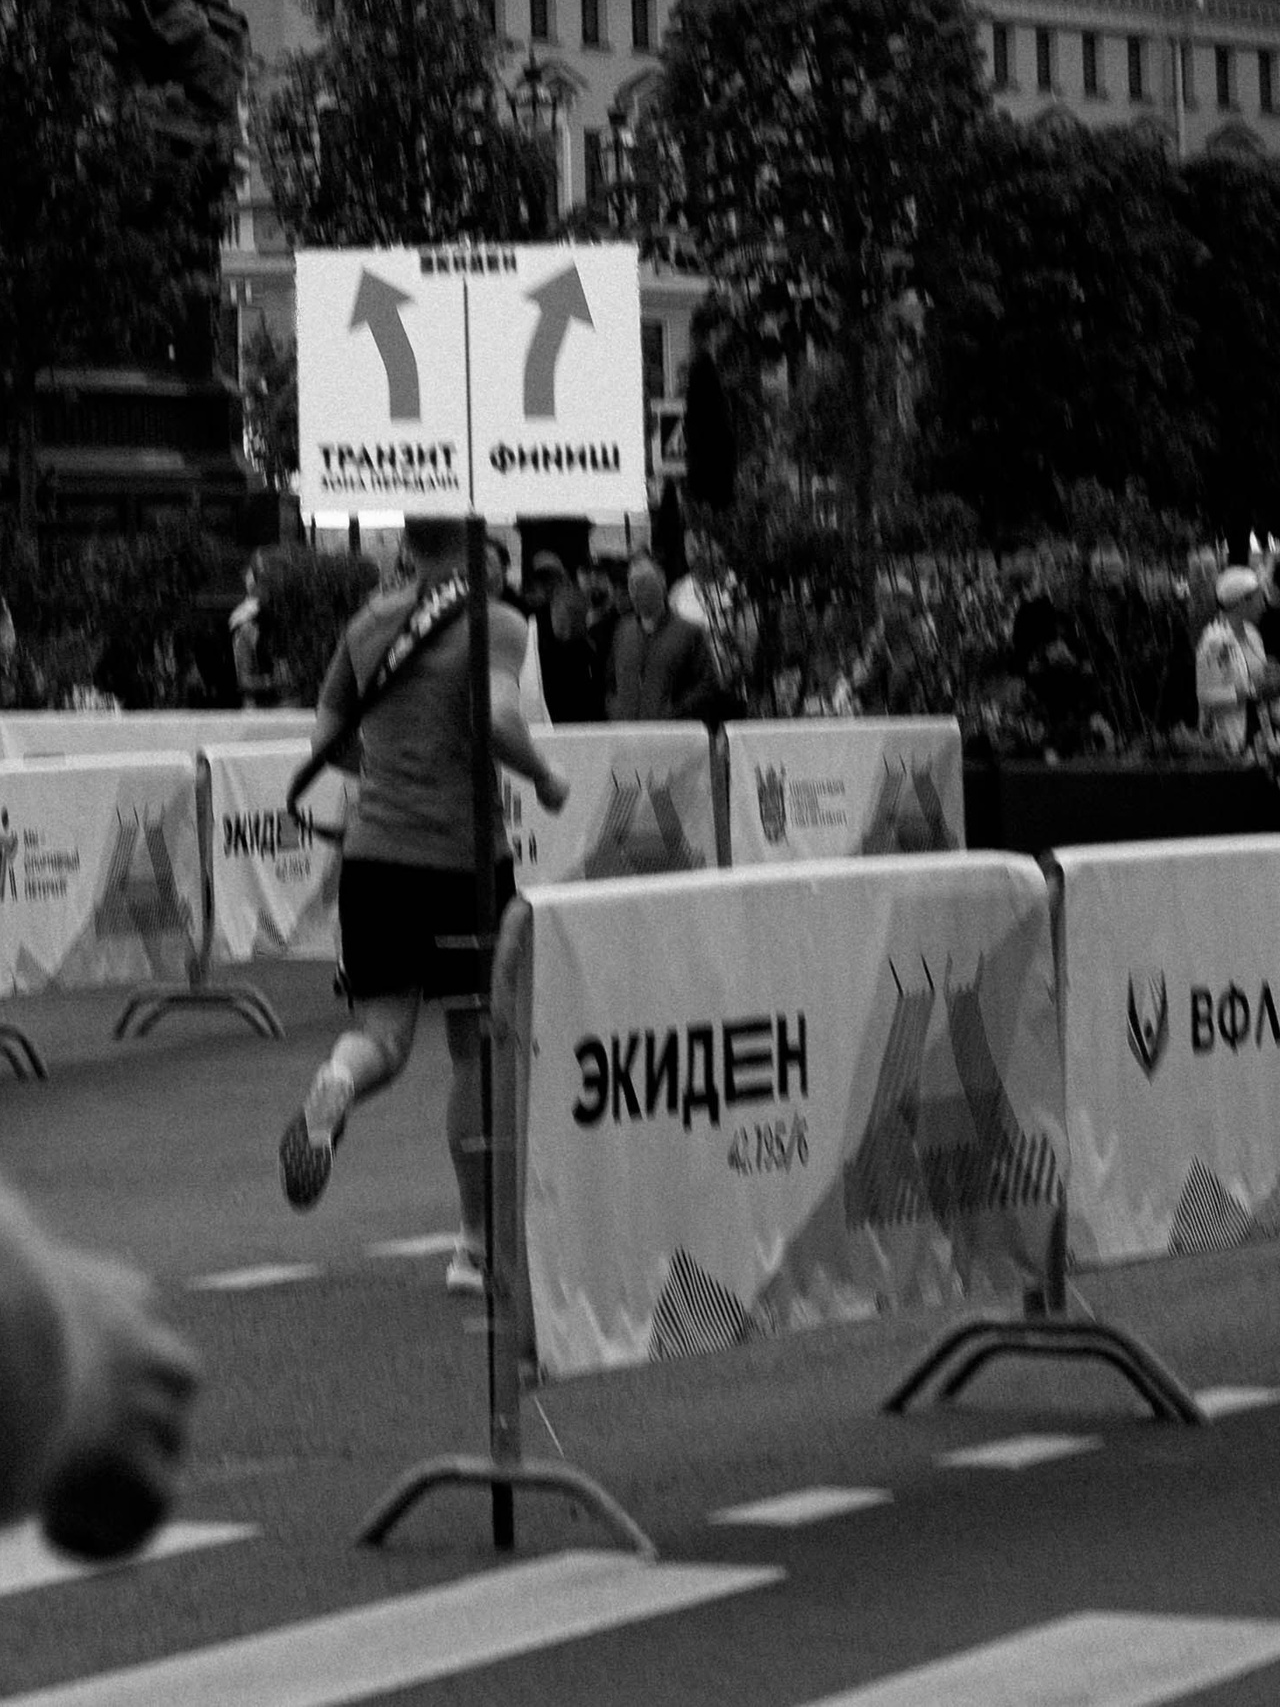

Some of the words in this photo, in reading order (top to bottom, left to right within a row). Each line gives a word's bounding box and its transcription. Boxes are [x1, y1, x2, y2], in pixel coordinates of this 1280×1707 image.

[318, 441, 458, 472] ТРАНЗИТ
[488, 442, 621, 474] ФИНИШ
[572, 1009, 810, 1132] ЭКИДЕН
